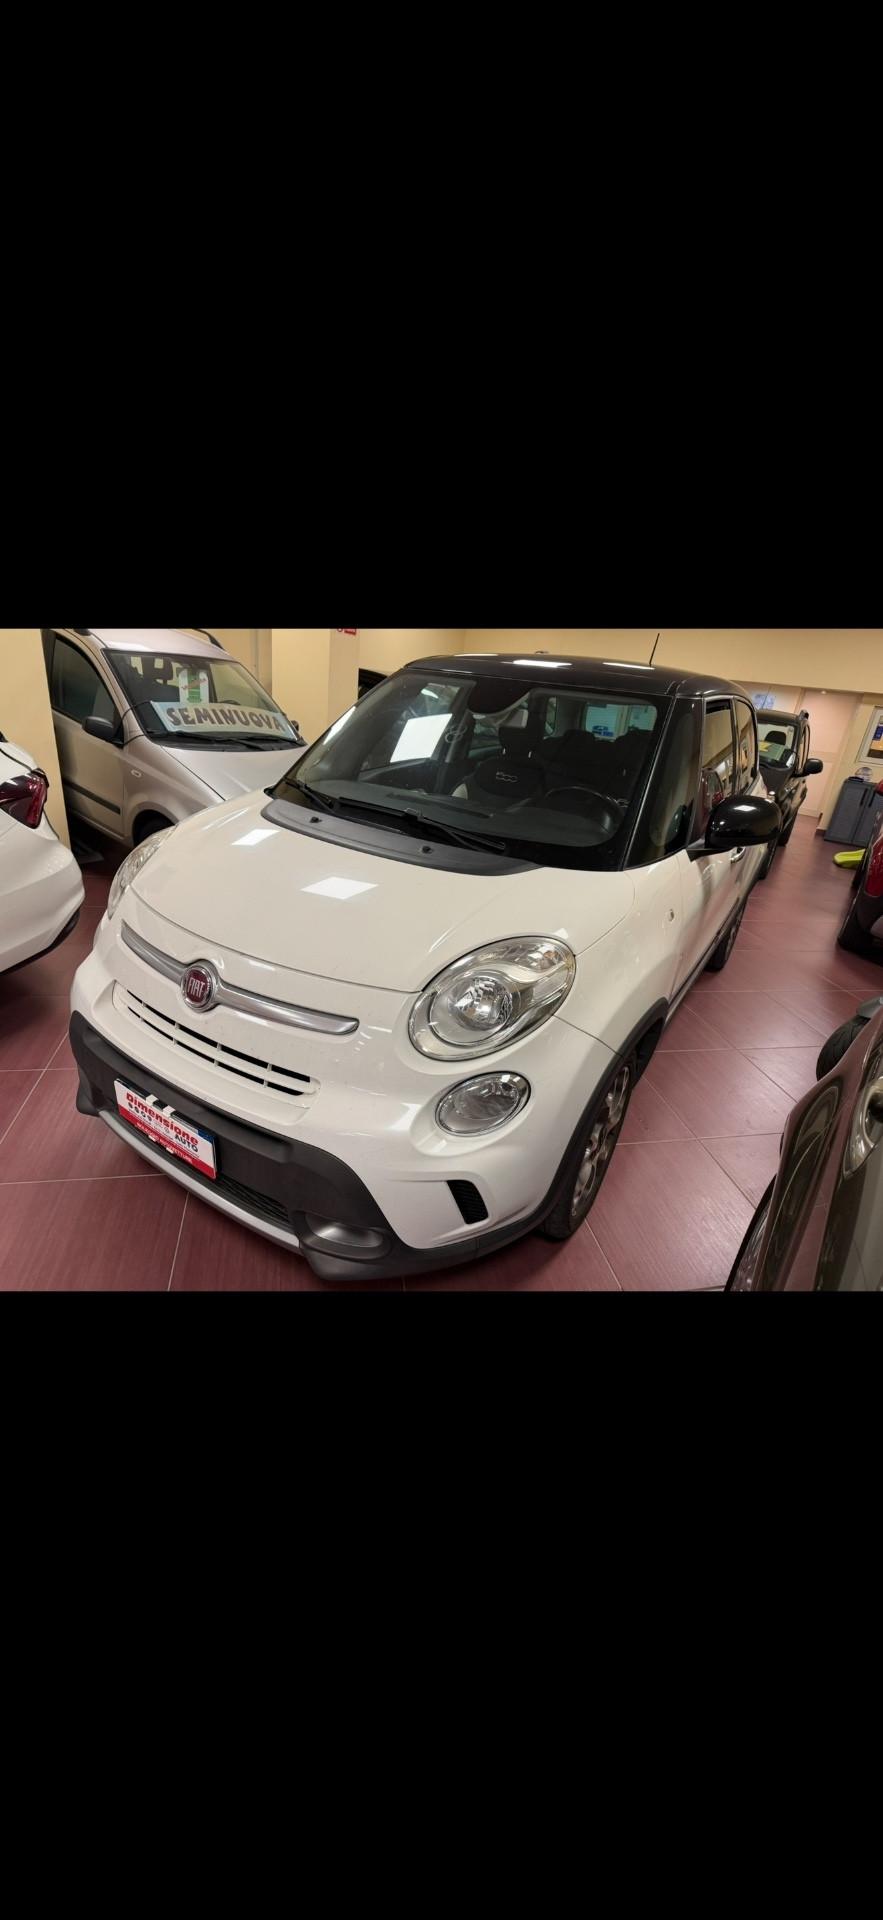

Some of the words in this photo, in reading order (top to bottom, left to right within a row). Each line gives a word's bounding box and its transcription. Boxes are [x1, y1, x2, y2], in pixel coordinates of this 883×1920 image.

[166, 708, 284, 731] SEMINUOVA
[188, 978, 205, 998] FIAT
[126, 1092, 199, 1146] Dimensione
[174, 1134, 199, 1153] AUTO
